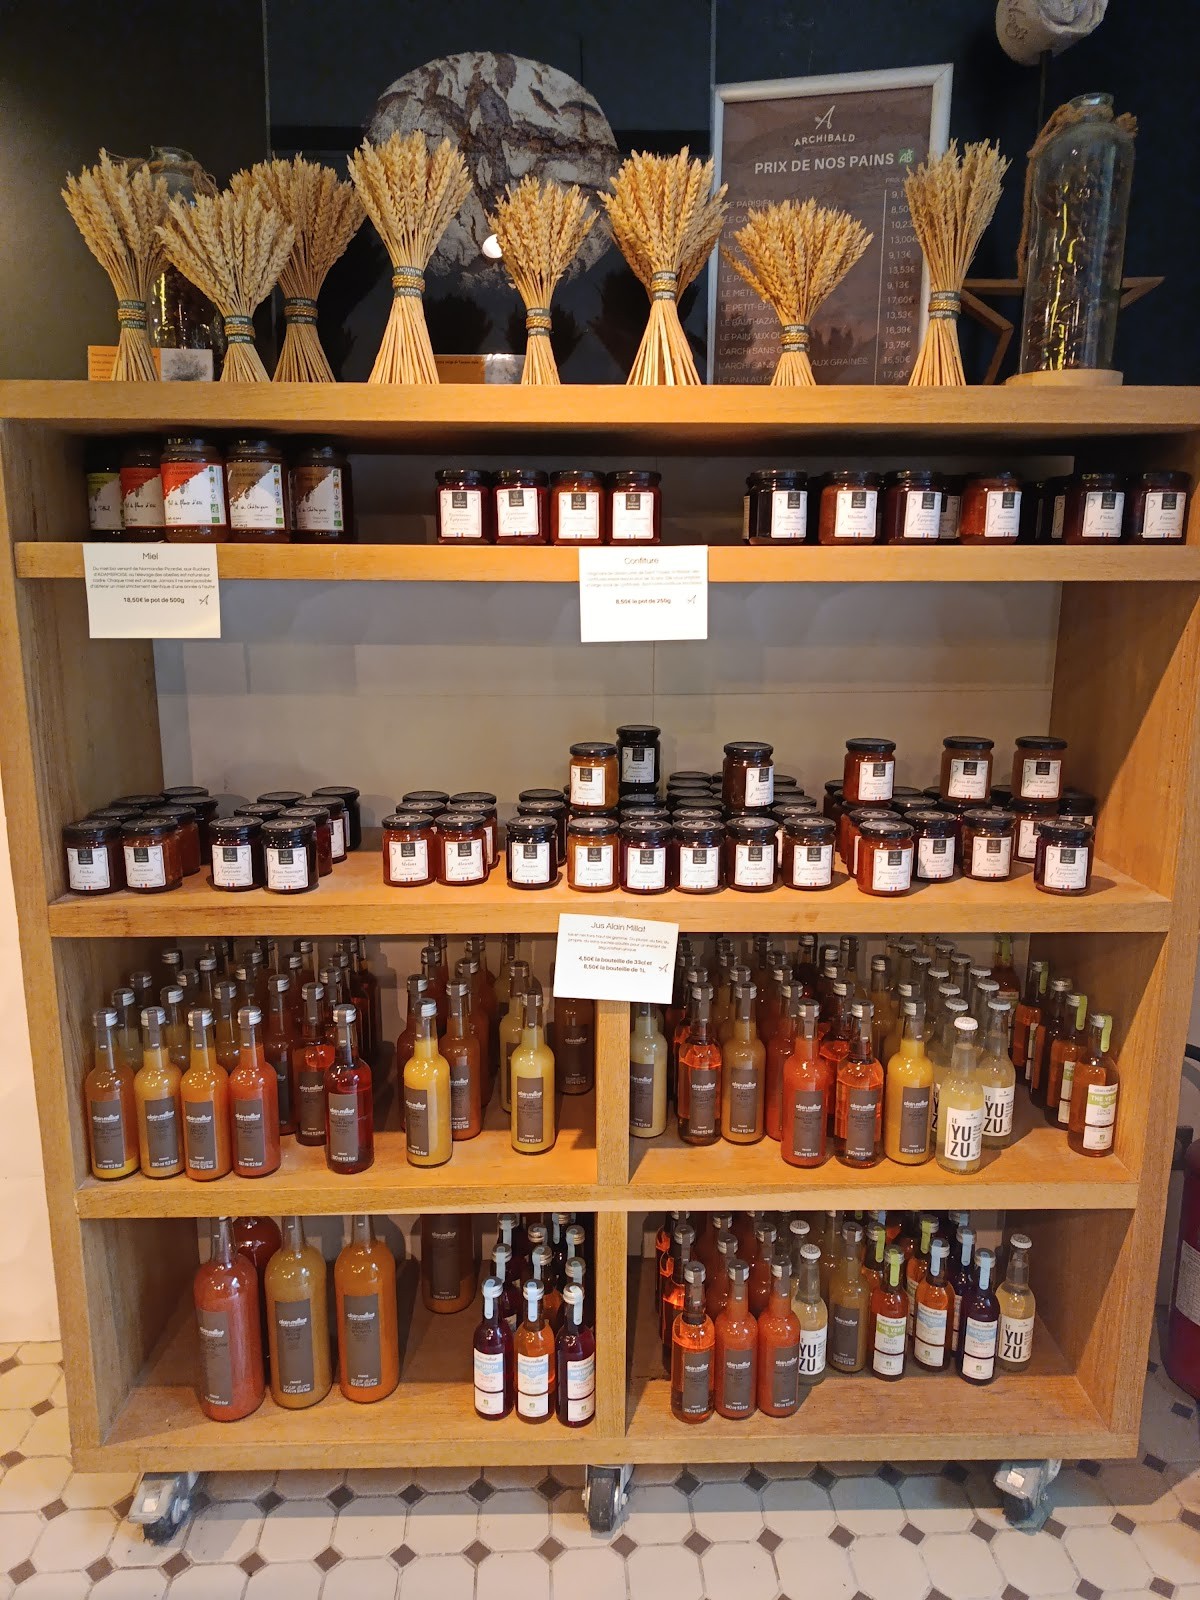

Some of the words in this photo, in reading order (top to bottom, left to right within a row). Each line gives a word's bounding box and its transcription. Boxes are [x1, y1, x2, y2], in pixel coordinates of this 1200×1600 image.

[794, 134, 856, 147] ARCHIBALD
[755, 161, 787, 174] PRIX
[791, 159, 810, 172] DE
[814, 156, 846, 170] NOS
[850, 152, 894, 168] PAINS
[830, 357, 869, 366] GRAINES
[606, 922, 625, 930] Alain
[984, 1101, 1004, 1118] YU
[951, 1124, 972, 1142] YU
[984, 1117, 1003, 1134] ZU
[950, 1140, 970, 1158] ZU
[1005, 1330, 1024, 1346] YU
[1004, 1344, 1022, 1360] ZU
